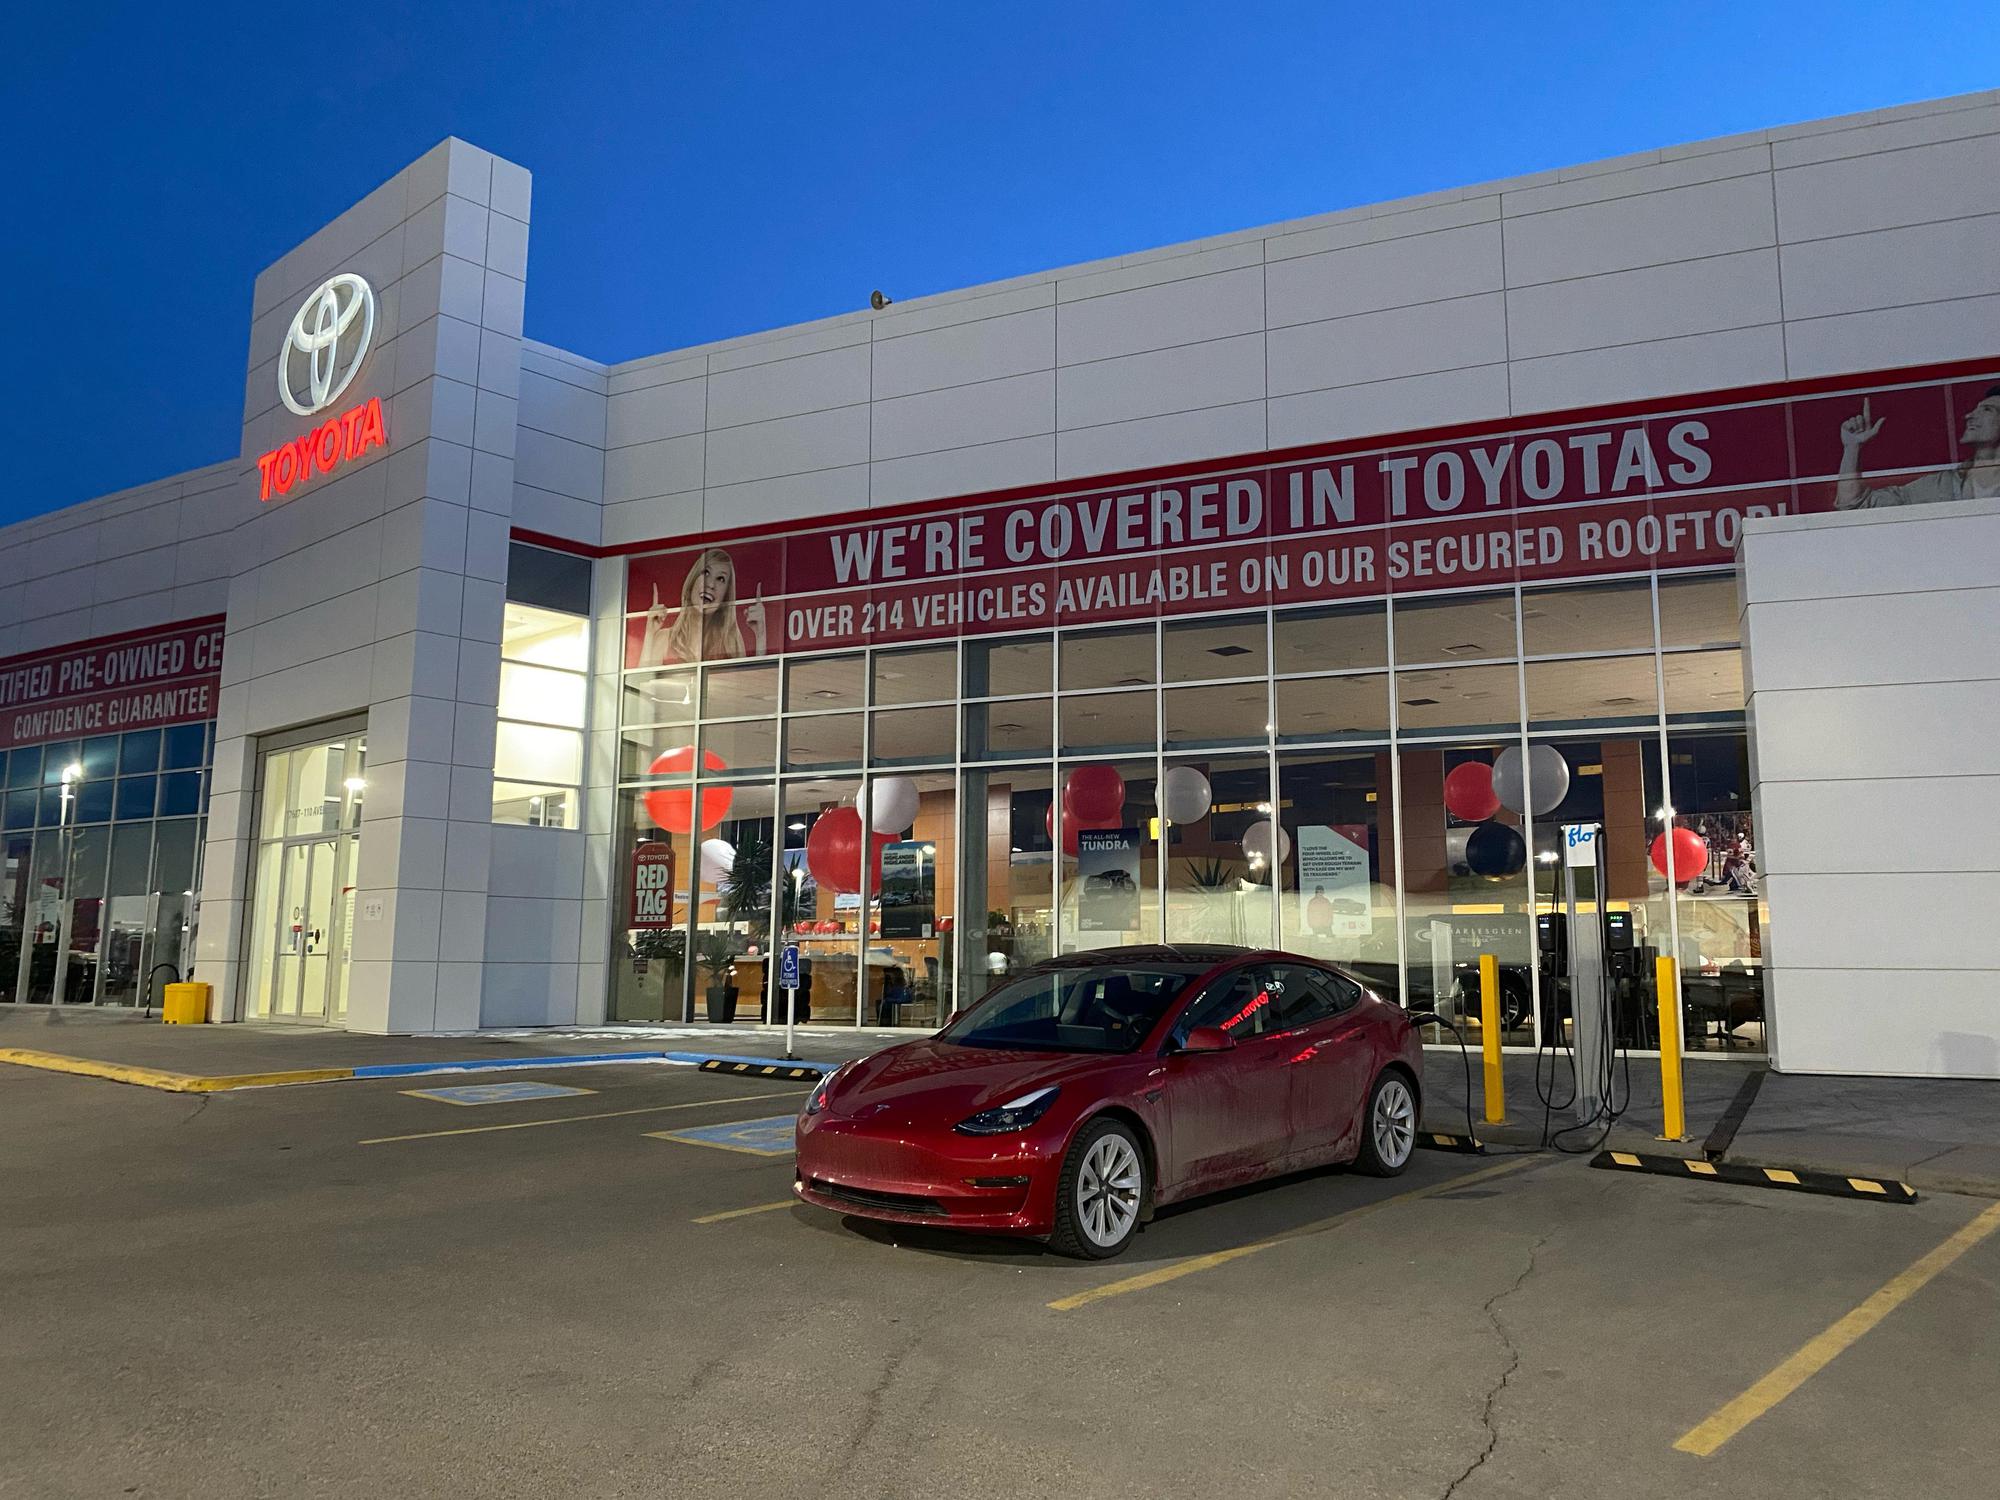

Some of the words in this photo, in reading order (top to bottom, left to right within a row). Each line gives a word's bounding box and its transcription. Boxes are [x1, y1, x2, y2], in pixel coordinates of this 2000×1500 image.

[257, 397, 384, 502] TOYOTA
[830, 515, 984, 583] WE'RE
[1004, 479, 1263, 563] COVERED
[1290, 464, 1355, 529] IN
[1379, 421, 1712, 516] TOYOTAS
[788, 604, 853, 640] OVER
[862, 600, 904, 633] 214
[912, 582, 1046, 628] VEHICLES
[1055, 561, 1228, 613] AVAILABLE
[1239, 554, 1288, 594] ON
[1302, 546, 1375, 588] OUR
[1388, 526, 1563, 578] SECURED
[58, 639, 185, 693] PRE-OWNED
[13, 702, 102, 740] CONFIDENCE
[108, 685, 209, 726] GUARANTEE
[1082, 840, 1130, 851] TUNDRA
[1568, 823, 1594, 847] flo
[636, 864, 669, 889] RED
[636, 889, 667, 914] TAG
